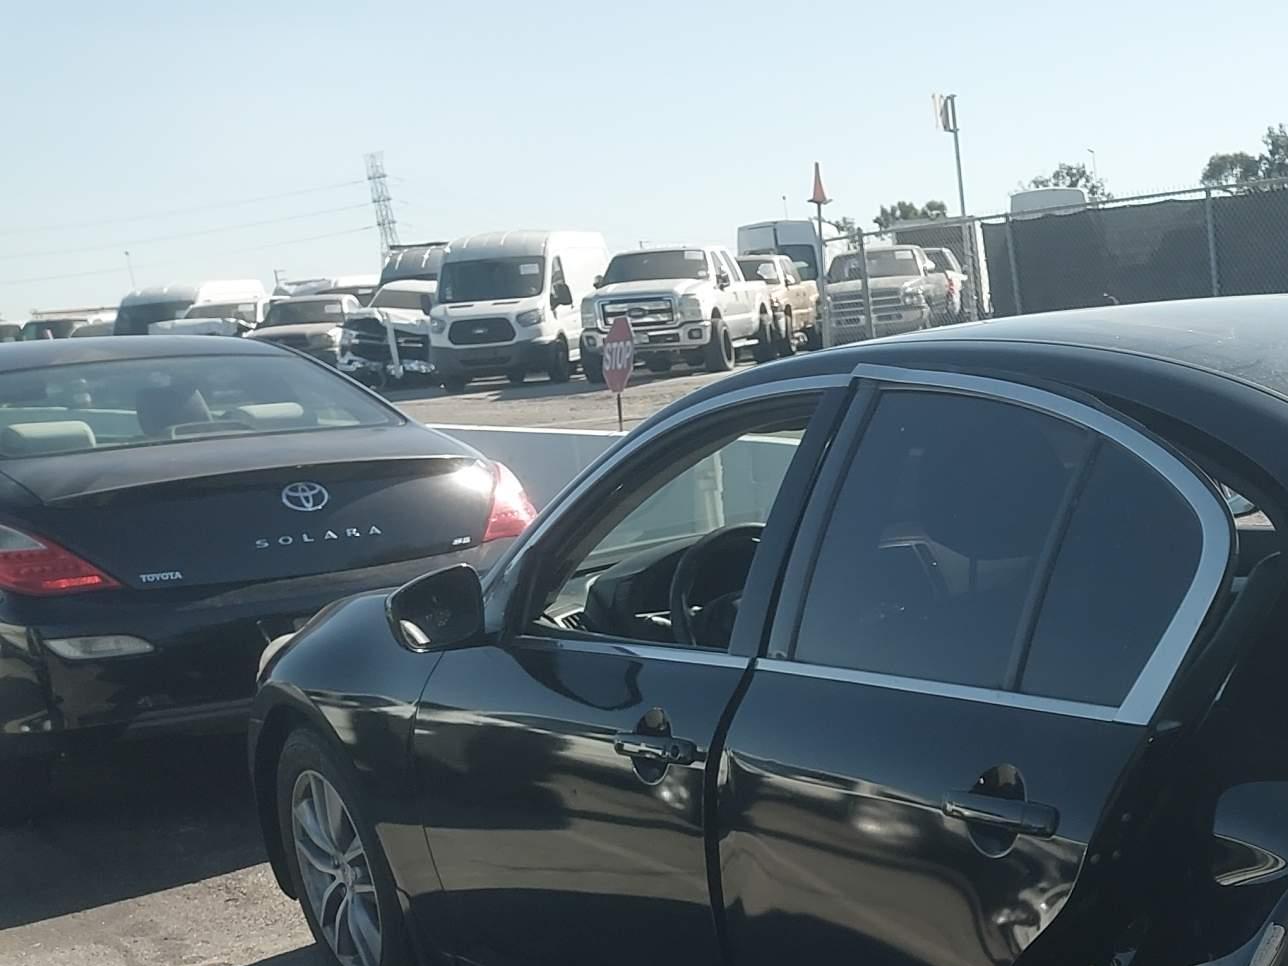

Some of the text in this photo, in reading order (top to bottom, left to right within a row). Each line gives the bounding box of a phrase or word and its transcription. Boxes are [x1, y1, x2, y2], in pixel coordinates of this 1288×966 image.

[603, 340, 632, 371] STOP
[255, 525, 383, 548] SOLARA
[139, 571, 182, 583] TOYOTA
